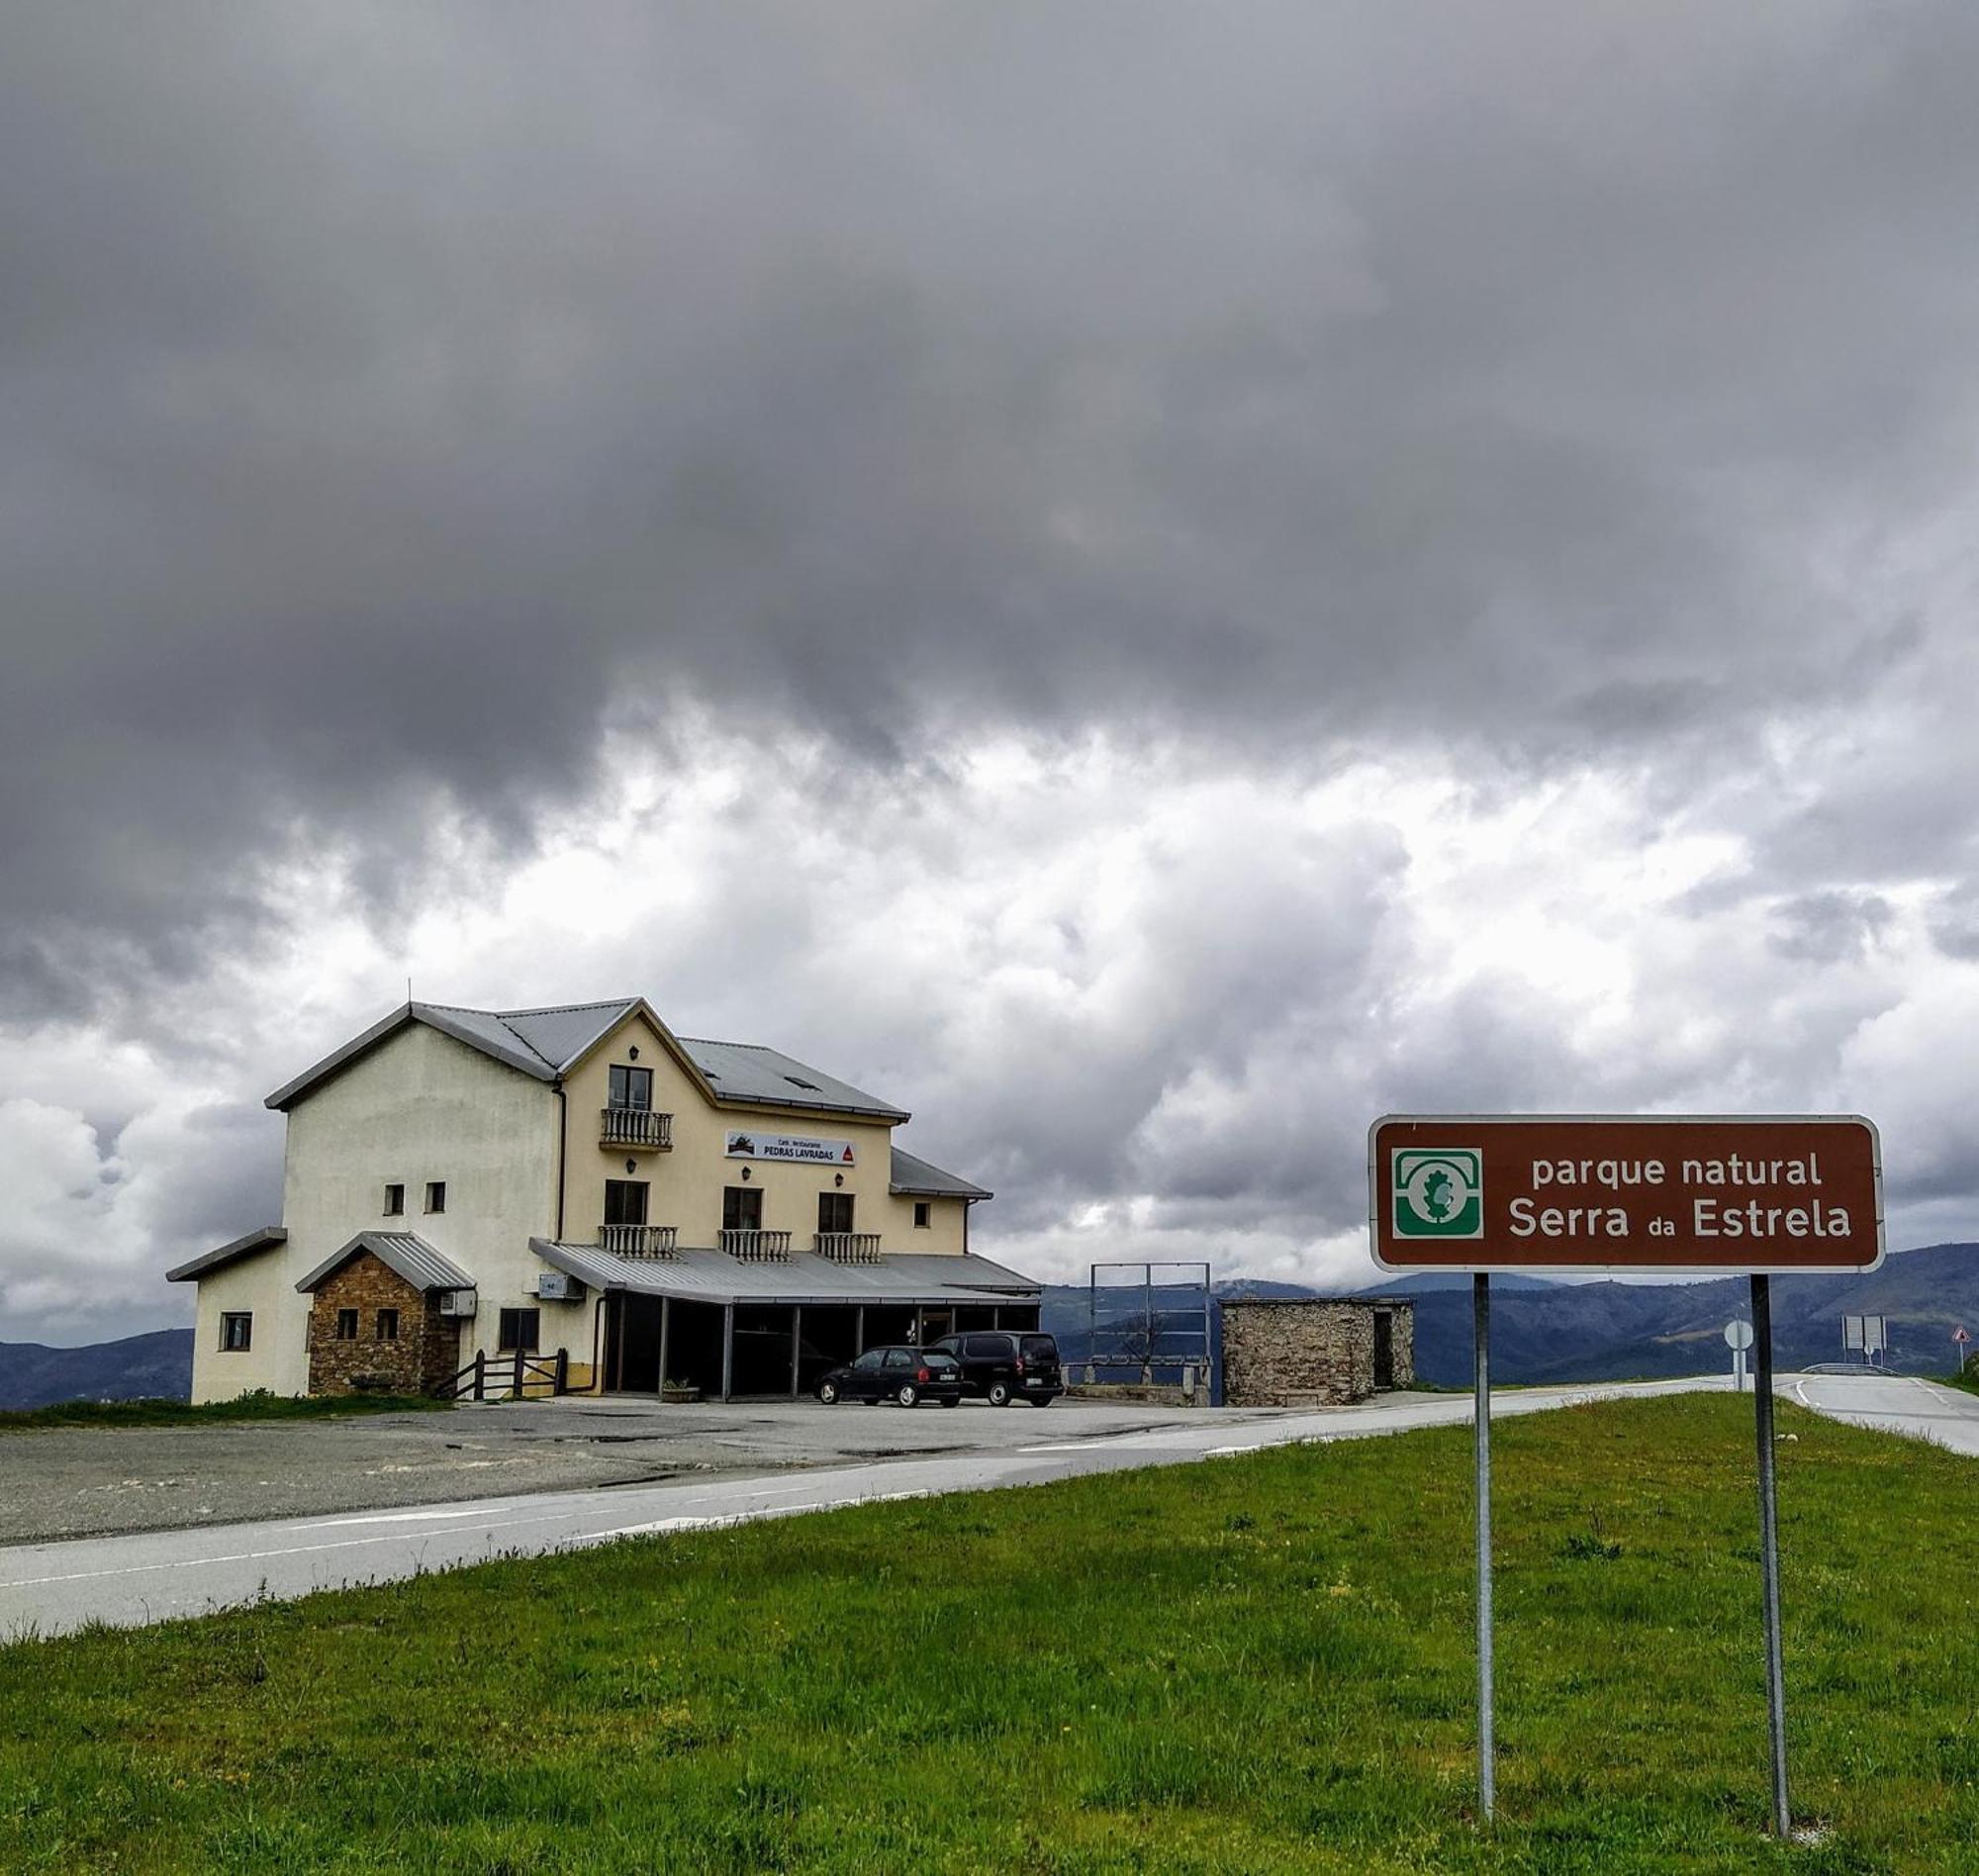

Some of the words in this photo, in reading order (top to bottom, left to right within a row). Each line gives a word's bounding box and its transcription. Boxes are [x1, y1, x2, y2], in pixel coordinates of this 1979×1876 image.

[764, 1146, 795, 1158] PEDRAS
[795, 1148, 834, 1161] LAVRADAS
[1532, 1158, 1665, 1190] parque
[1682, 1152, 1822, 1185] natural
[1509, 1198, 1629, 1237] Serra
[1648, 1216, 1675, 1236] da
[1693, 1198, 1851, 1237] Estrela
